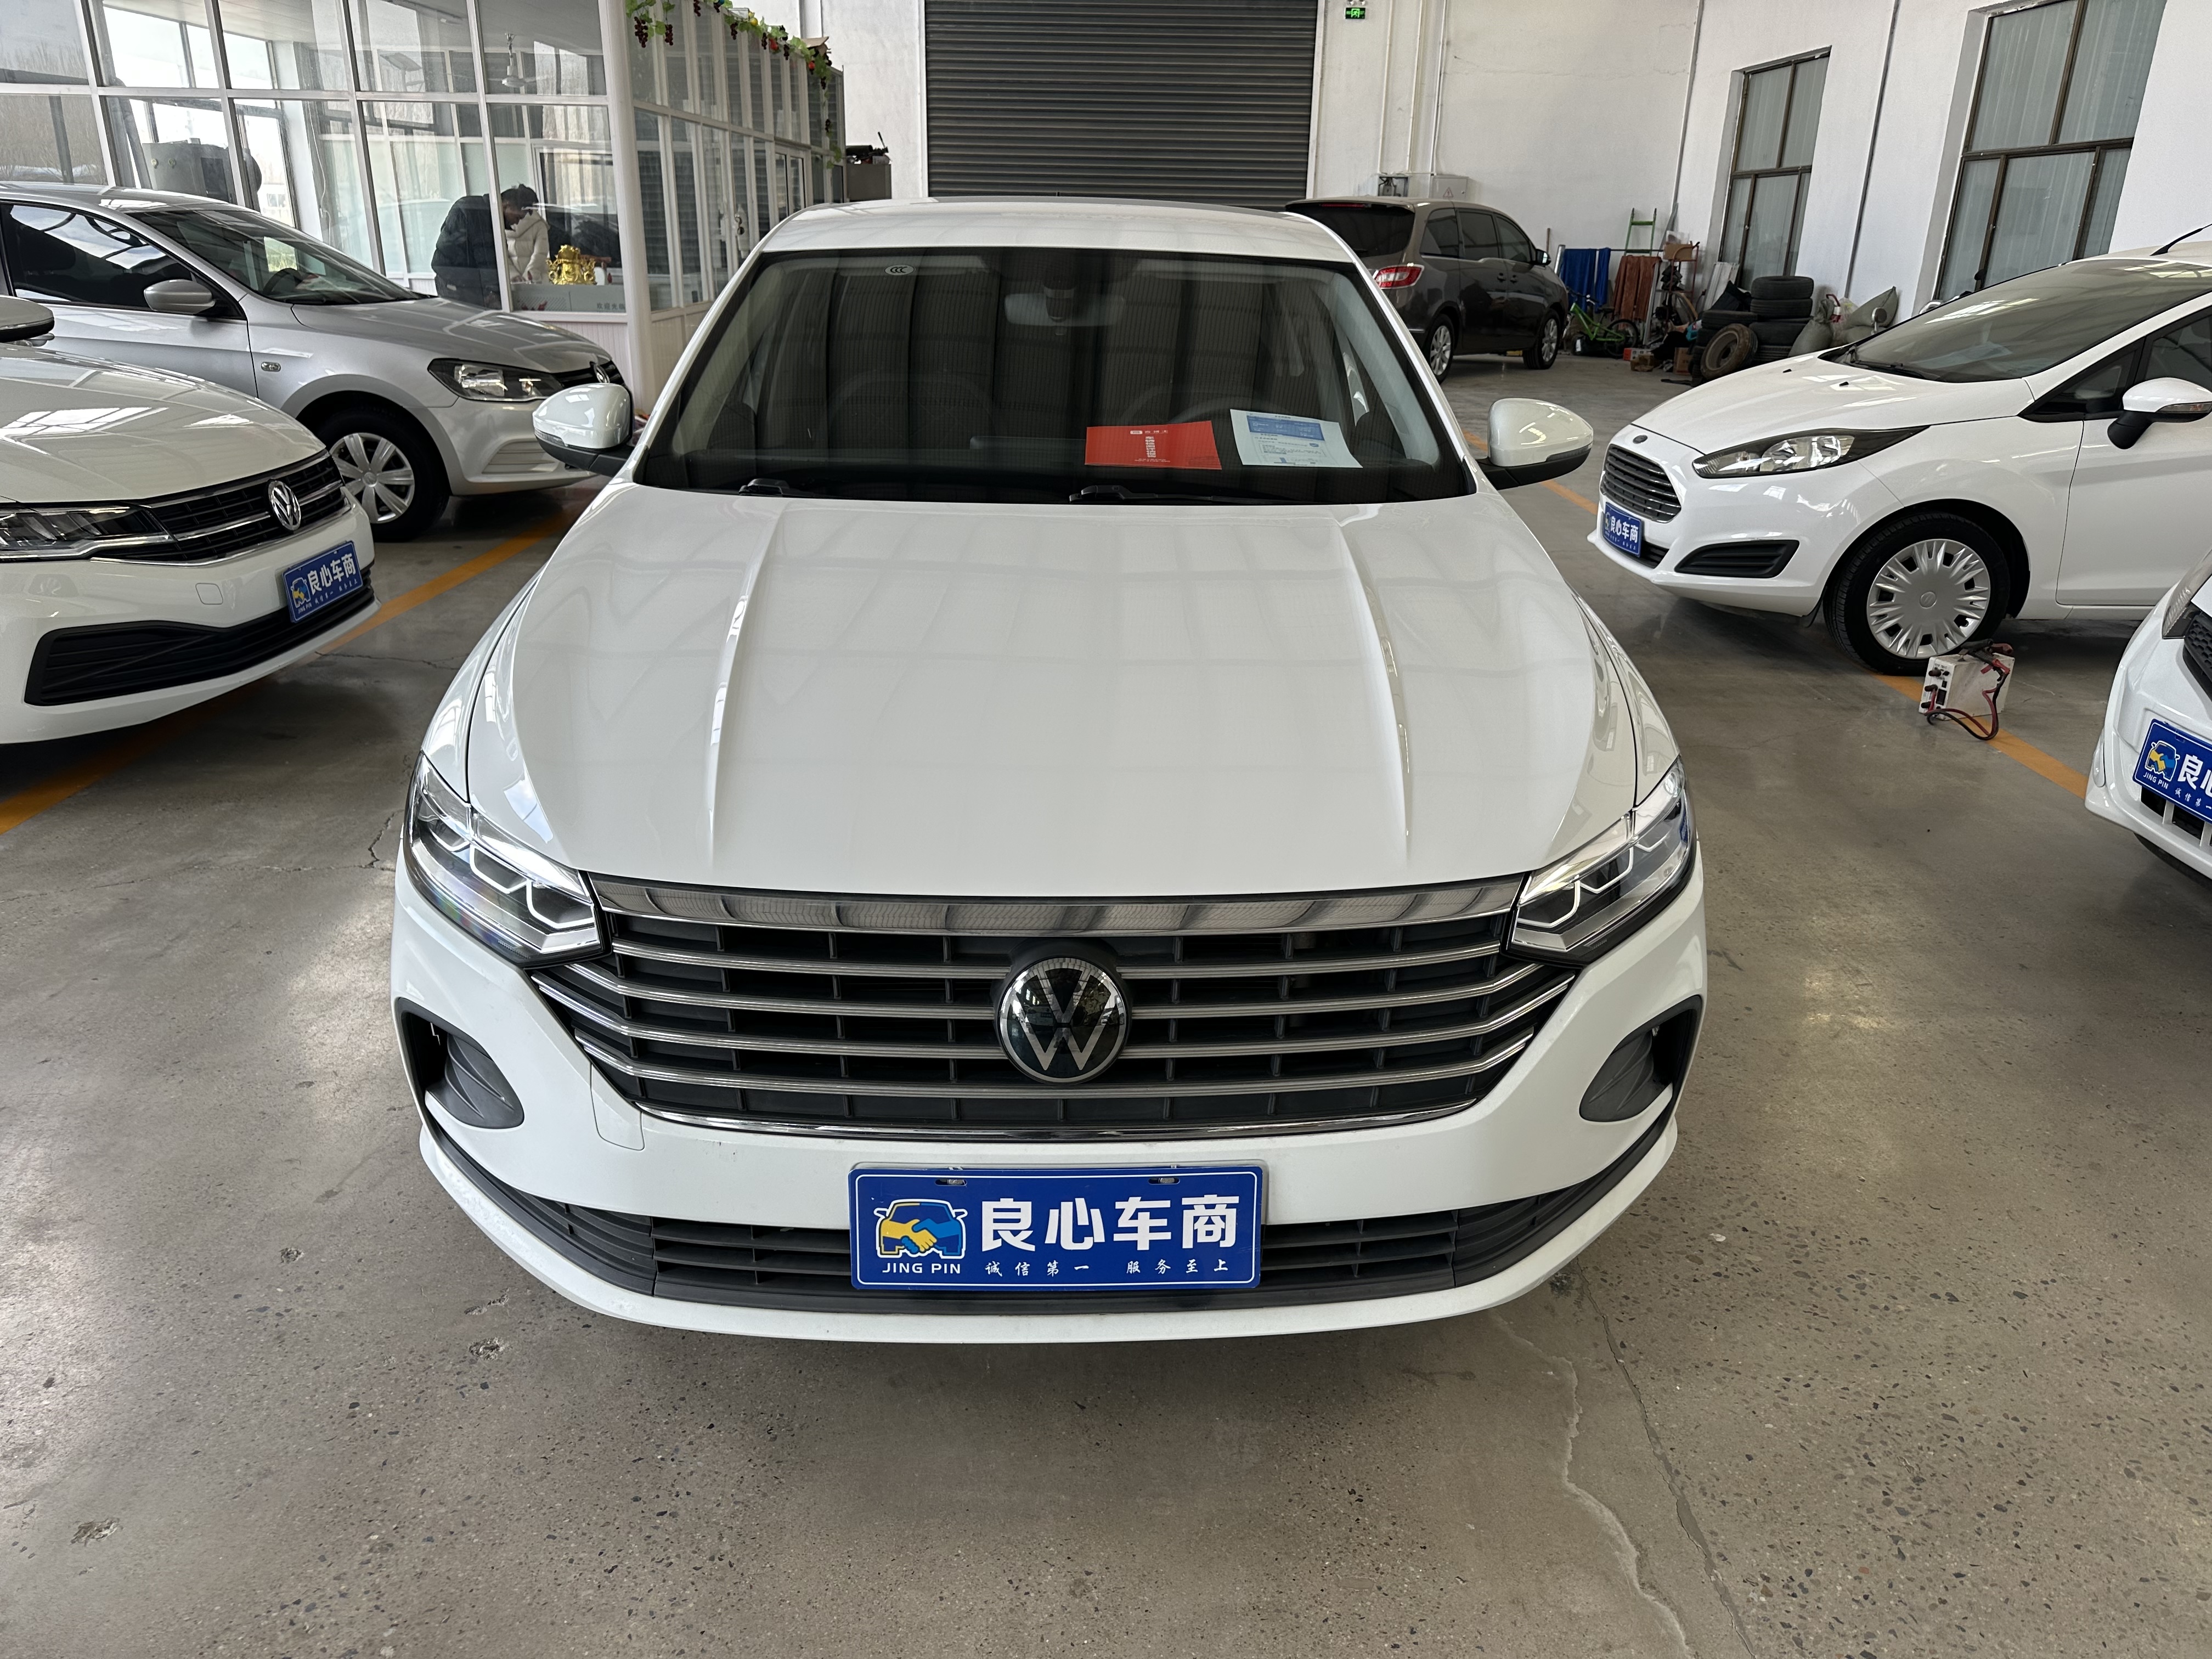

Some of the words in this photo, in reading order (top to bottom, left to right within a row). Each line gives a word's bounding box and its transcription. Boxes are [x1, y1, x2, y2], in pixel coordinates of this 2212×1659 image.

[1610, 516, 1639, 543] 良心车商
[307, 553, 356, 595] 良心车商
[2143, 772, 2157, 783] JING
[2158, 779, 2169, 789] PIN
[980, 1194, 1240, 1251] 良心车商
[882, 1262, 923, 1274] JING
[931, 1262, 961, 1274] PIN
[985, 1260, 1090, 1277] 诚信第一
[1126, 1259, 1229, 1274] 服务至上
